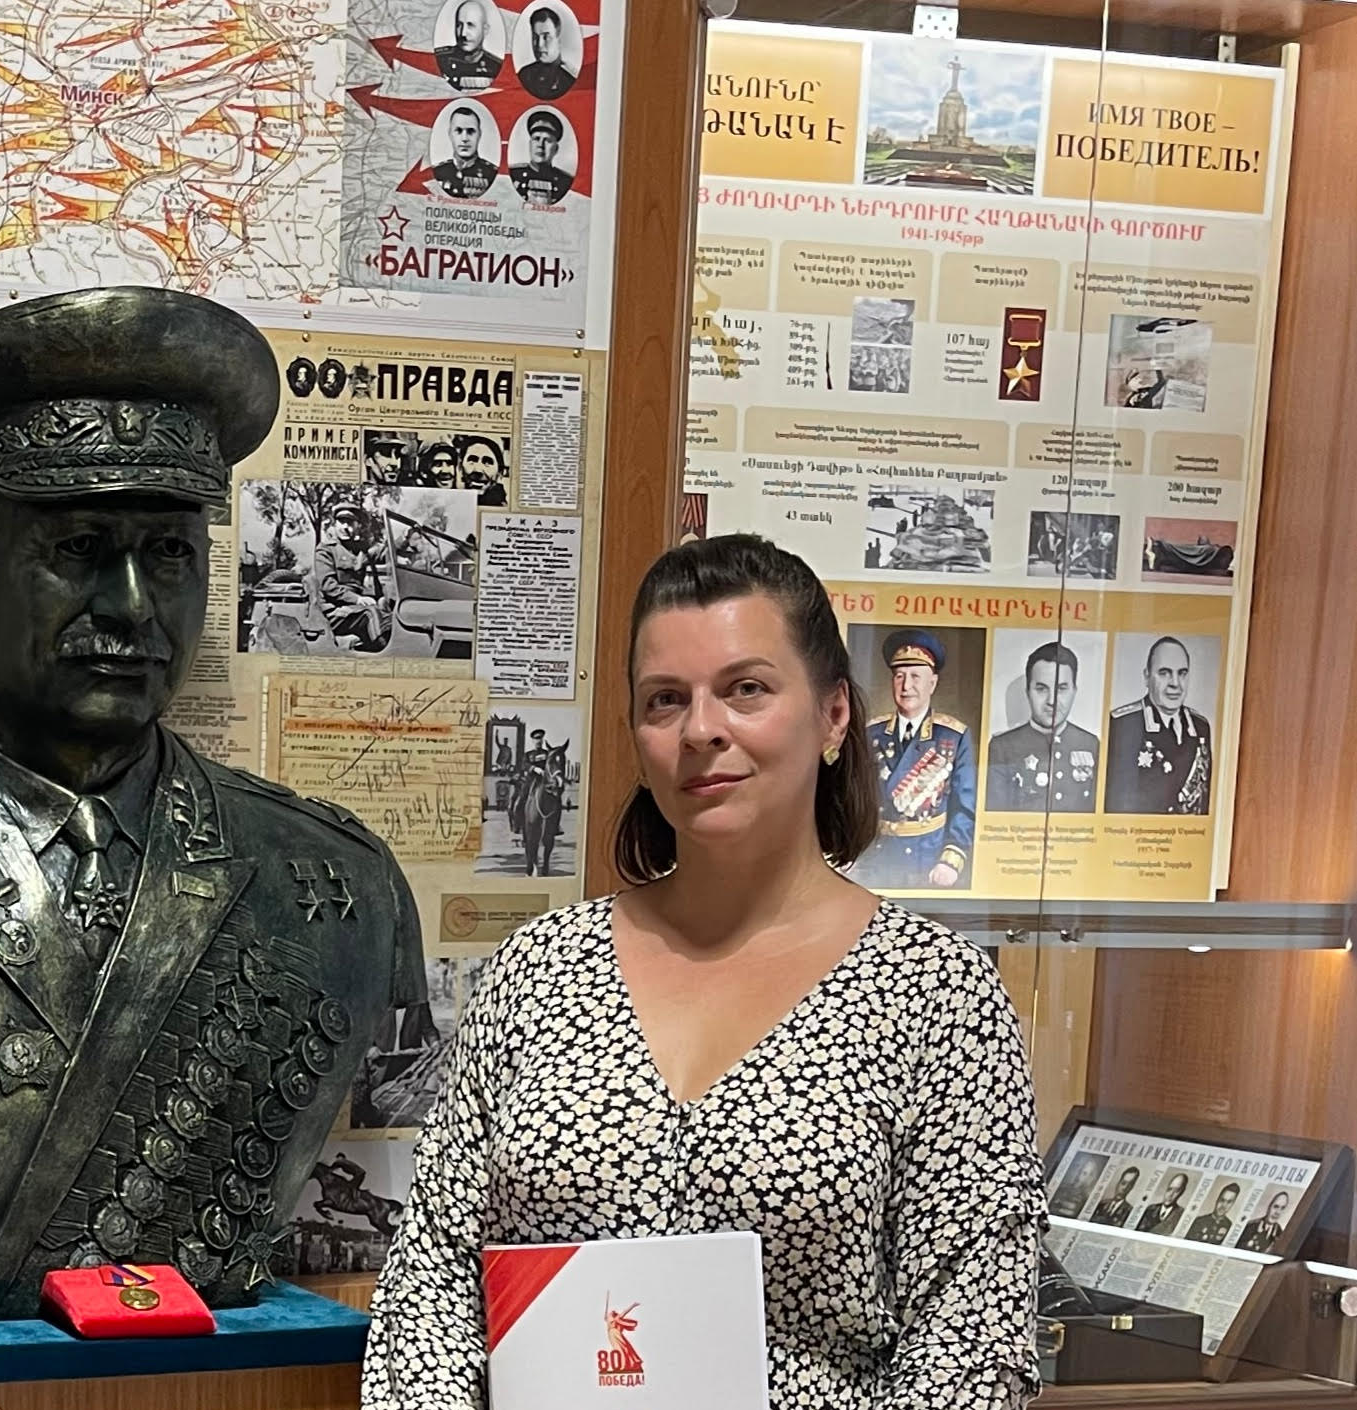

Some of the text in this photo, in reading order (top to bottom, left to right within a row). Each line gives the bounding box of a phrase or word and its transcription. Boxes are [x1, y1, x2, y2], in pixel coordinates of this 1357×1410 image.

[60, 85, 125, 106] Минск
[1088, 102, 1144, 127] ИМЯ
[1152, 107, 1217, 133] ТВОЕ
[825, 117, 846, 144] Է
[1055, 133, 1260, 173] ПОБЕДИТЕЛЬ!
[425, 206, 502, 222] ПОЛКОВОДЦЫ
[715, 188, 835, 213] ԺՈՂՈՎՐԴԻ
[841, 197, 969, 225] ՆԵՐԴՐՈՒՄԸ
[974, 208, 1105, 233] ՀԱՂԹԱՆԱԿԻ
[1110, 218, 1208, 242] ԳՈՐԾՈՒՄ
[425, 220, 525, 238] ВЕЛИКОЙ ПОБЕДЫ
[424, 233, 483, 248] ОПЕРАЦИЯ
[365, 245, 574, 288] «БАГРАТИОН»
[947, 333, 990, 349] 107 հայ
[377, 363, 513, 407] ПРАВДА
[348, 403, 375, 415] Орган
[379, 406, 439, 417] Центрального
[487, 411, 512, 421] КПСС
[284, 426, 360, 445] ПРИМЕР
[284, 444, 359, 461] КОММУНИСТА
[1051, 474, 1068, 485] 120
[1167, 482, 1184, 492] 200
[785, 510, 798, 521] 43
[1213, 1156, 1309, 1183] ПОЛКОВОДЦЫ
[597, 1350, 622, 1373] 80
[598, 1374, 645, 1387] ПОБЕДА!
